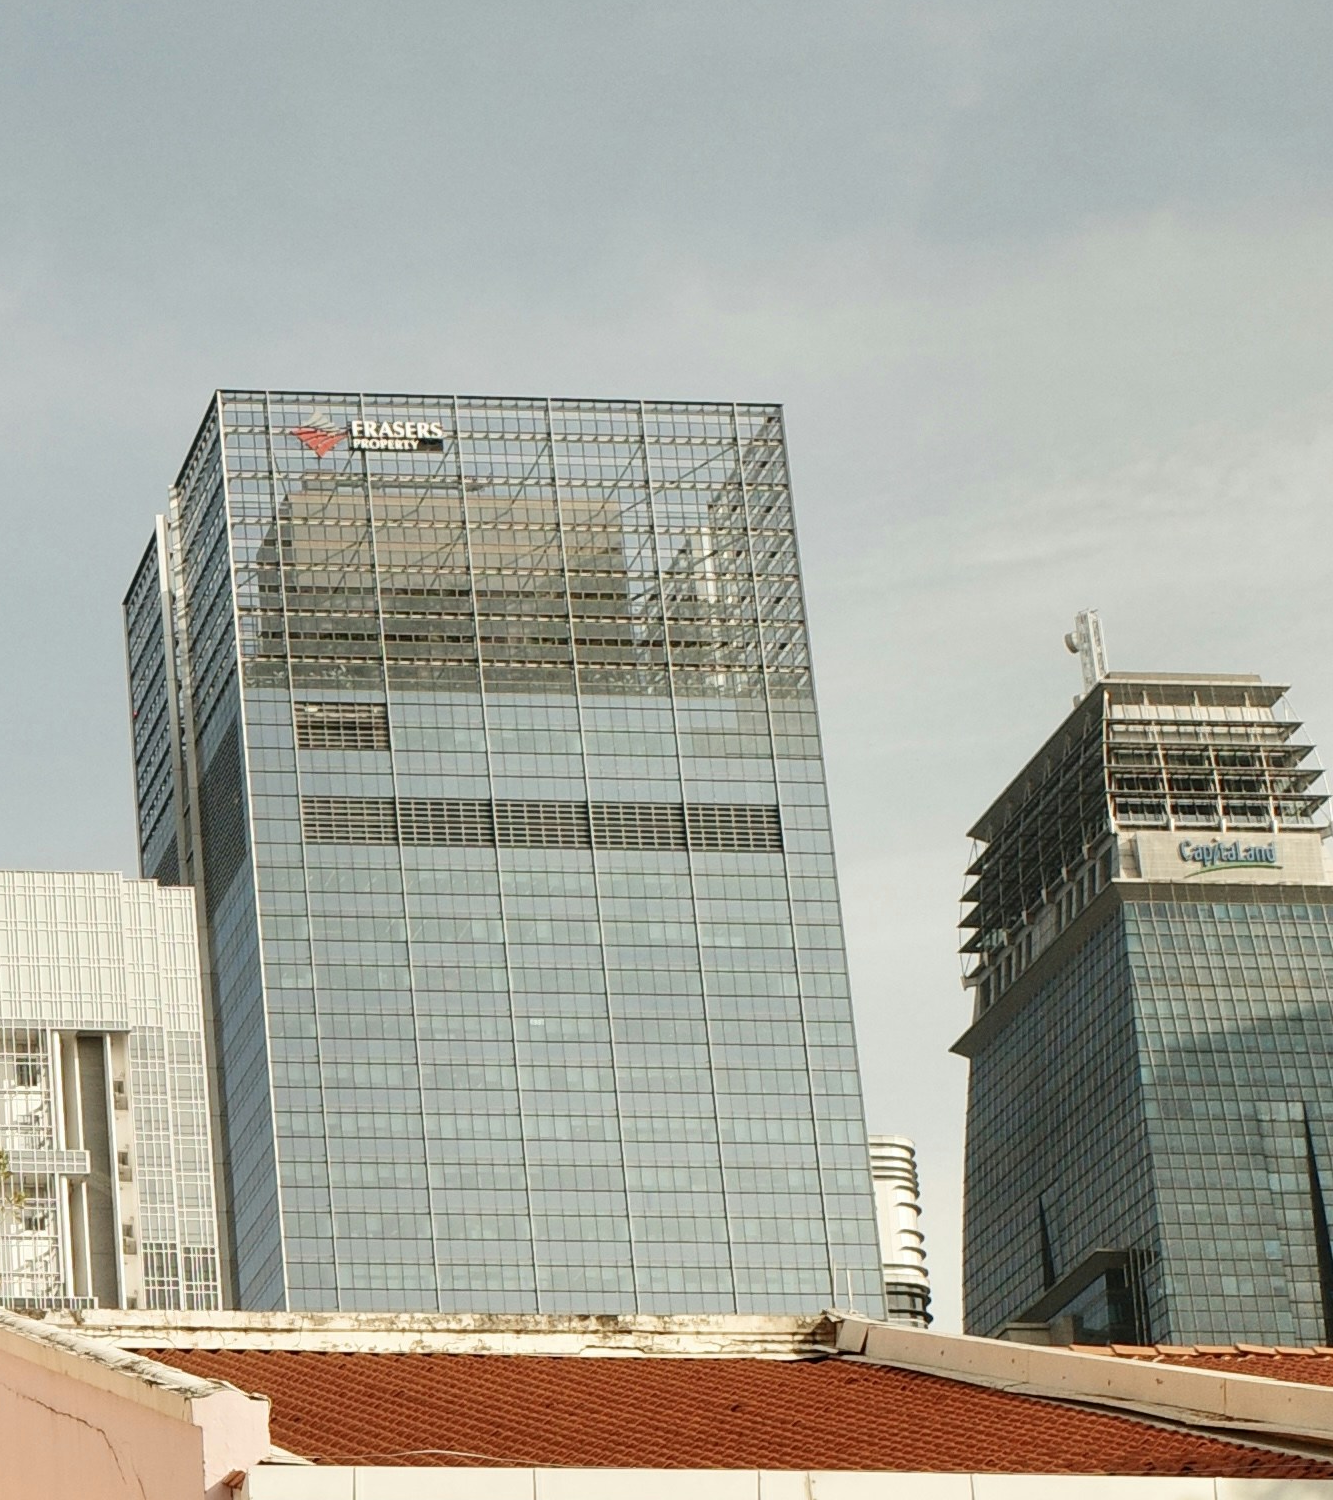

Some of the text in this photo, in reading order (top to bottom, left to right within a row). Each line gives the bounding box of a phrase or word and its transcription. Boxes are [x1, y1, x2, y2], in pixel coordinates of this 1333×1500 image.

[351, 420, 443, 438] FRASERS
[353, 438, 420, 450] PROPERTY
[1179, 837, 1276, 867] CapitaLand
